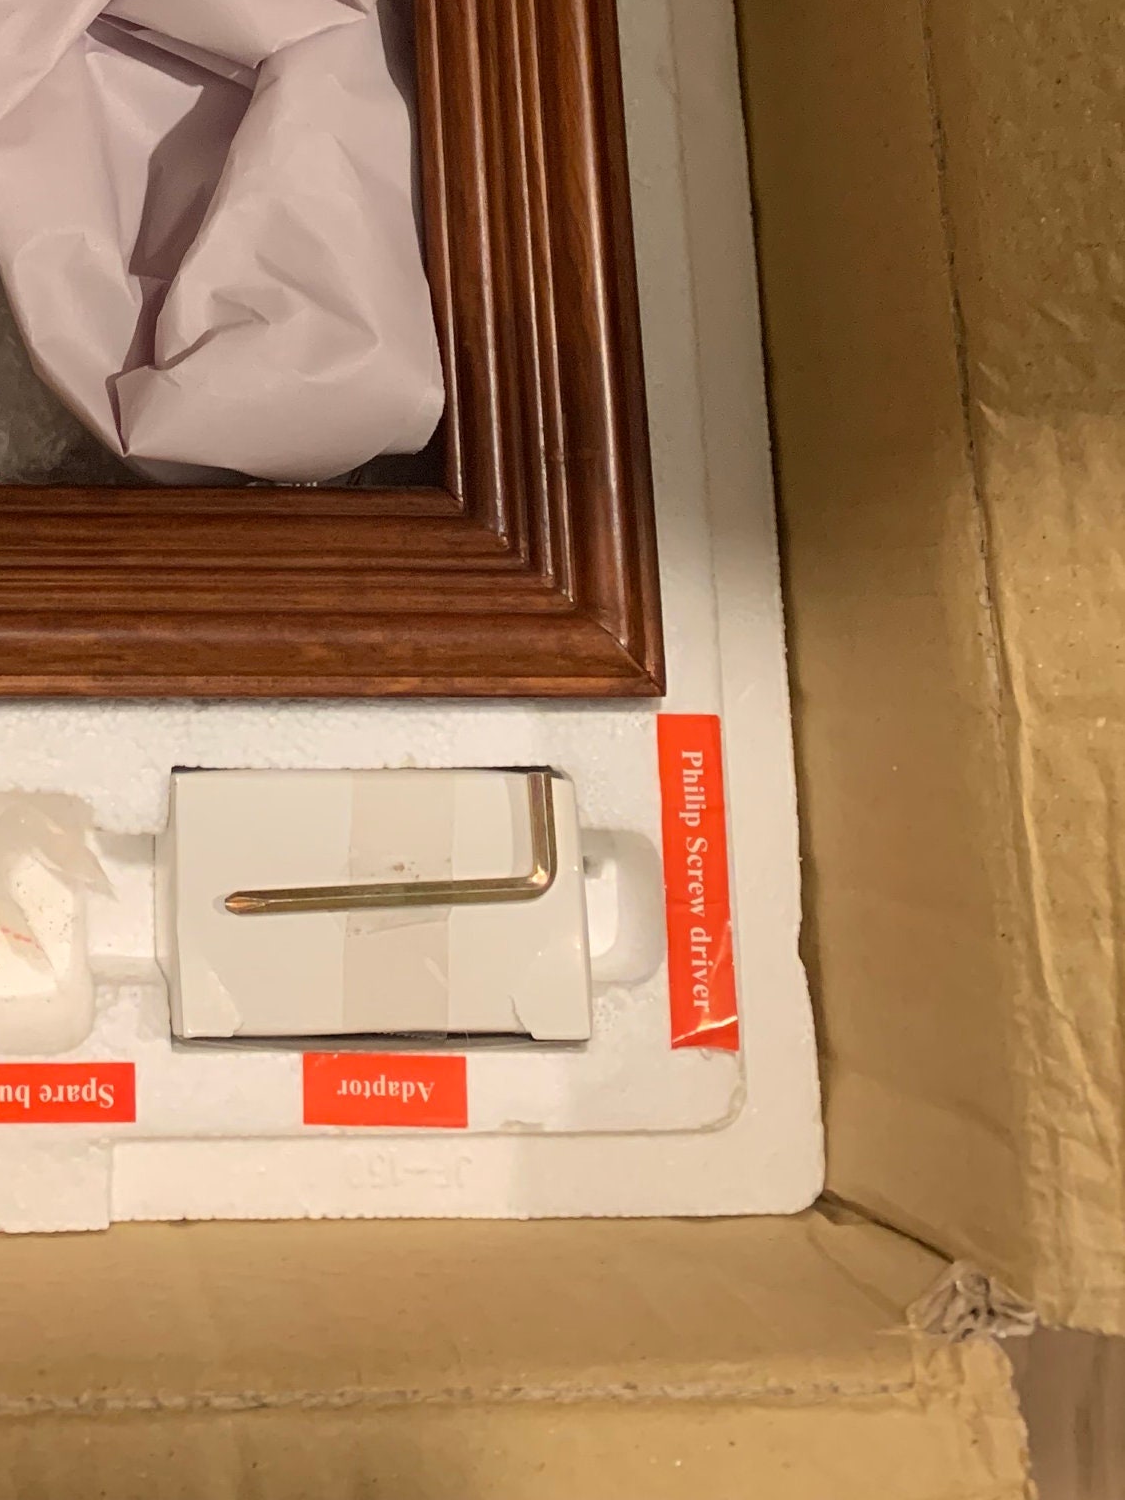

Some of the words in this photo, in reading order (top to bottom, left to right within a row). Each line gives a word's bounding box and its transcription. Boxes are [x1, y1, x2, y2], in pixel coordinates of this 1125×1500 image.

[678, 750, 704, 828] Philip
[684, 836, 710, 918] Screw
[689, 926, 714, 1015] driver
[39, 1077, 115, 1109] Spare
[336, 1075, 437, 1103] Adaptor
